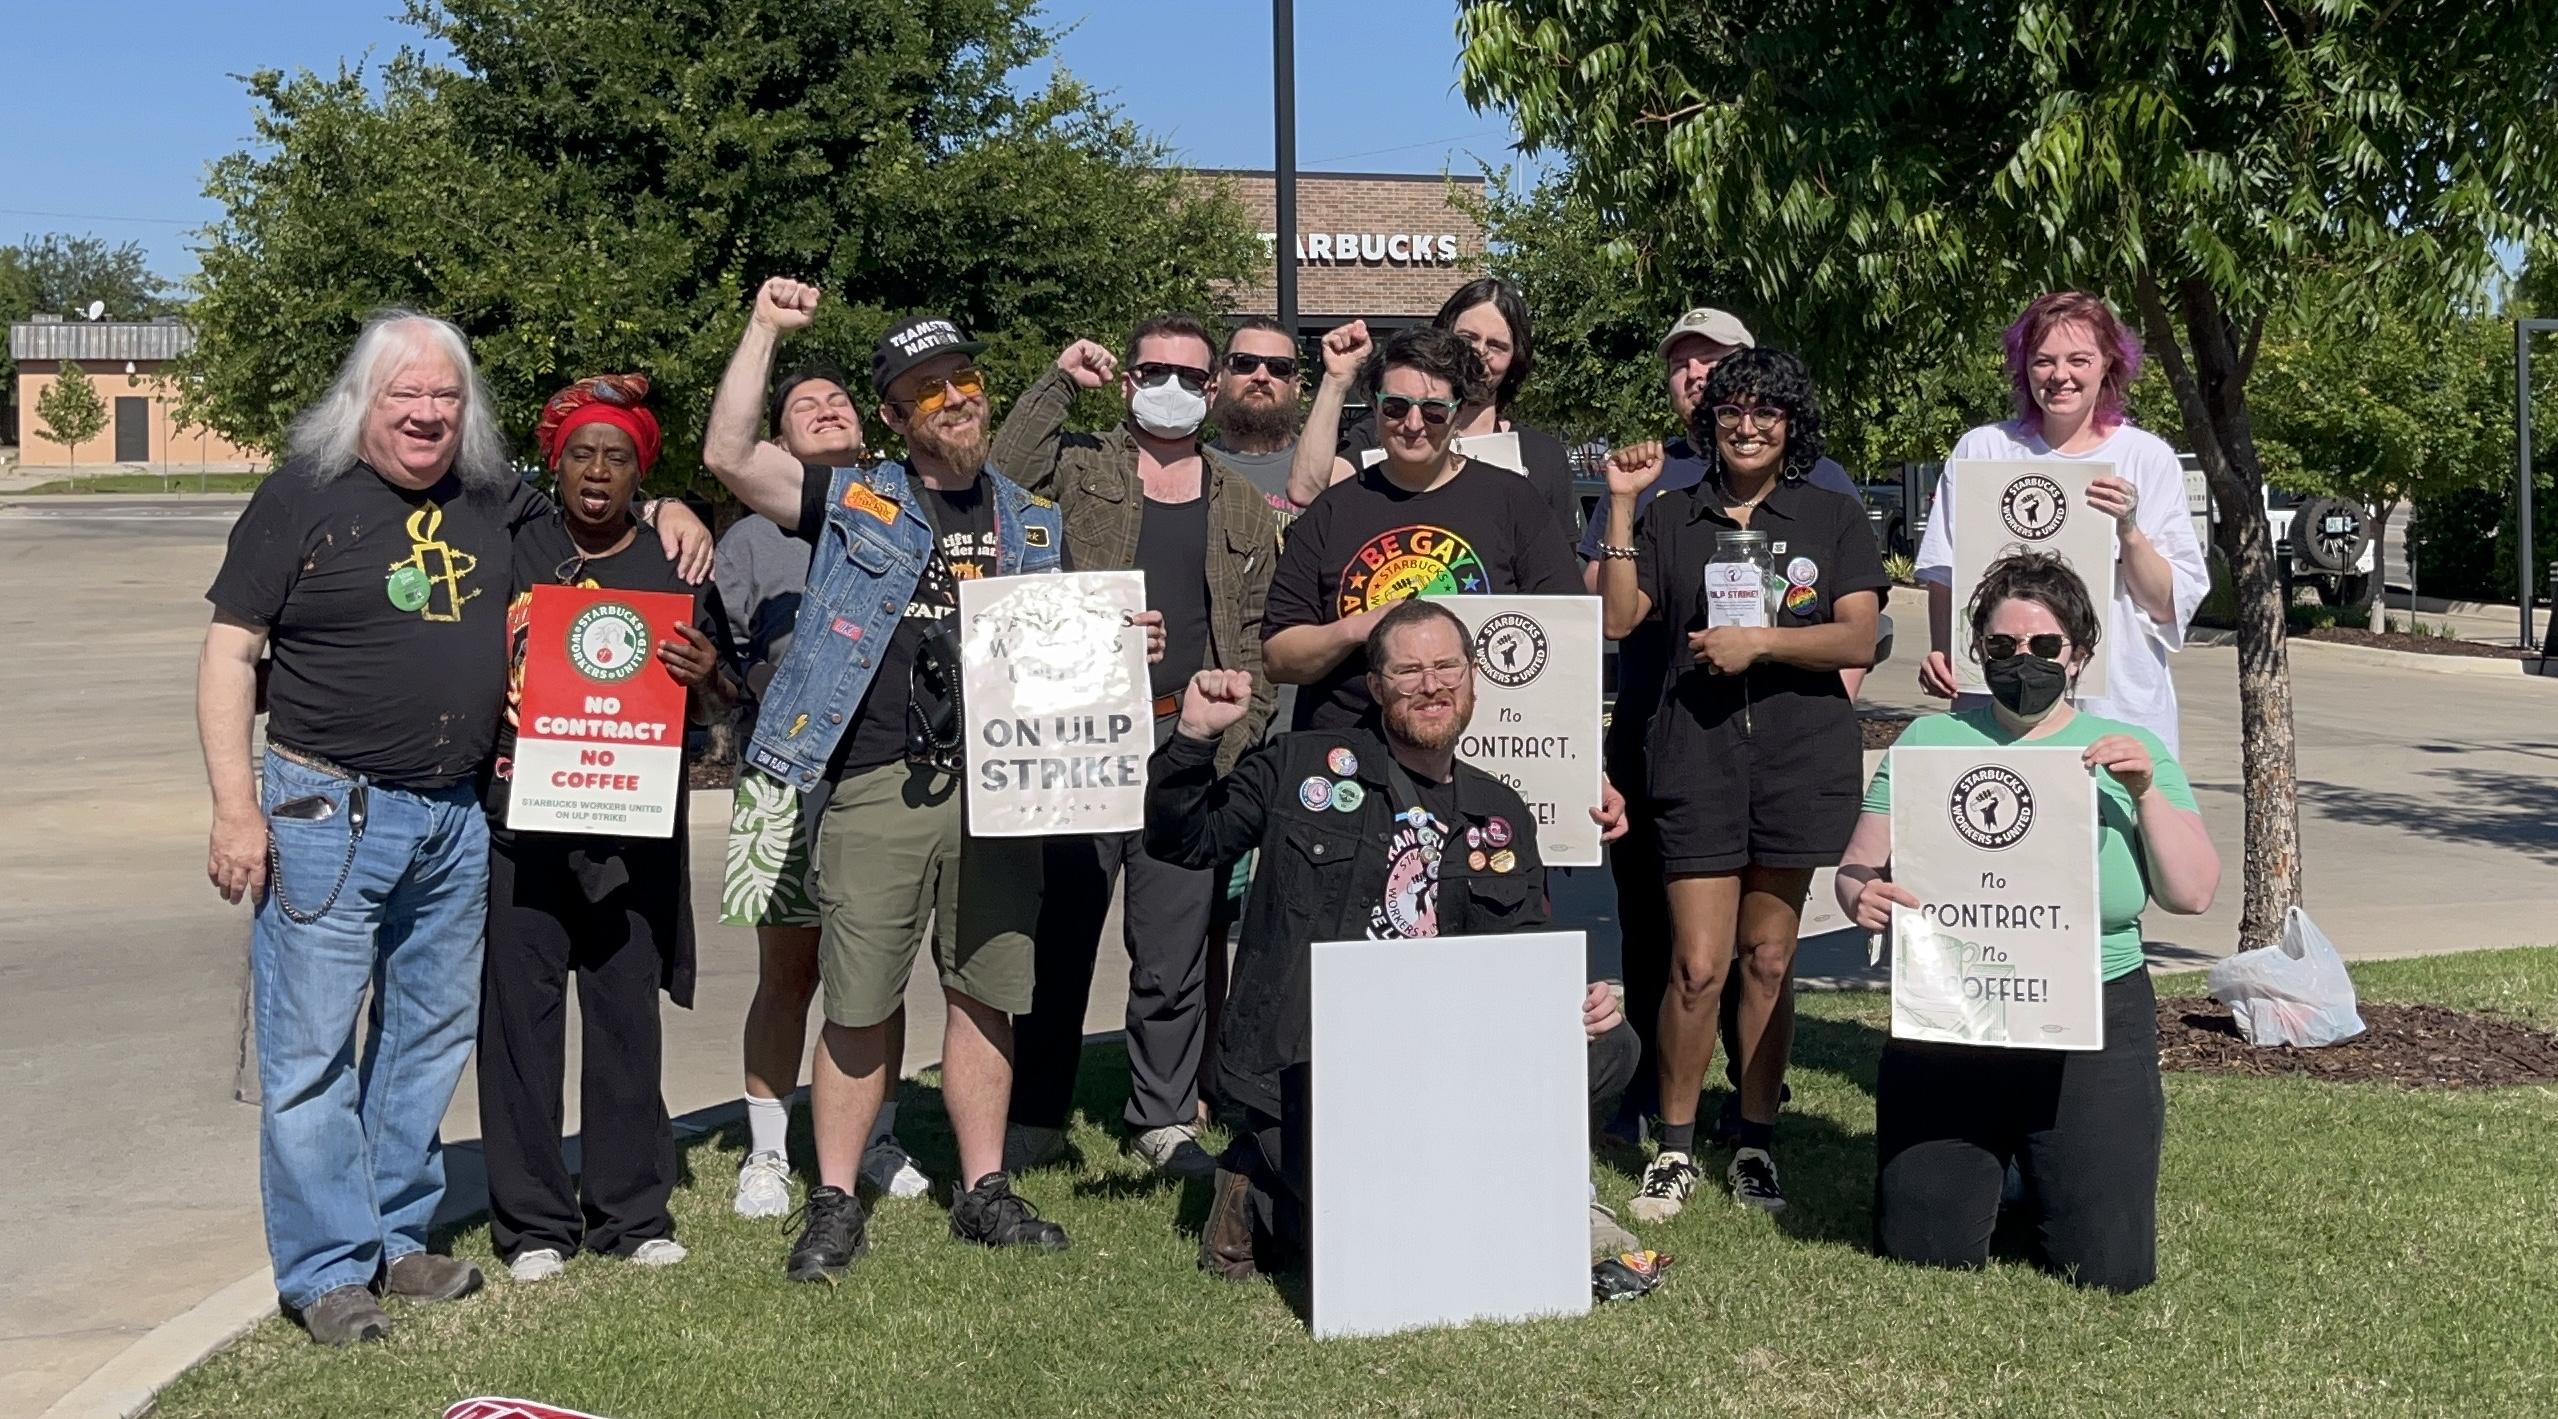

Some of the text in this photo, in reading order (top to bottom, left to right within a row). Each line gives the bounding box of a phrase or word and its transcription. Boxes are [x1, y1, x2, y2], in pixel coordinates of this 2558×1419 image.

[2009, 475, 2061, 498] STARBUCKS
[2002, 504, 2065, 538] WORKERS UNITED
[1360, 531, 1475, 572] BE GAY
[1380, 559, 1449, 583] STARBUCKS
[577, 605, 644, 632] STARBUCKS
[1484, 616, 1541, 640] STARBUCKS
[571, 633, 647, 679] WORKERS UNITED
[1476, 647, 1545, 684] WORKERS UNITED
[584, 695, 621, 715] NO
[534, 716, 667, 741] CONTRACT
[982, 714, 1132, 749] ON ULP
[580, 749, 615, 767] NO
[1456, 736, 1576, 760] ONTRACT,
[551, 770, 640, 792] COFFEE
[981, 754, 1142, 793] STRIKE
[1959, 768, 2025, 796] STARBUCKS
[522, 798, 663, 814] STARBUCKS WORKERS UNITED
[555, 811, 627, 823] ON ULP STRIKE!
[1951, 805, 2031, 846] WORKERS UNITED
[1388, 887, 1419, 938] WORKERS
[1921, 903, 2070, 932] CONTRACT,
[1960, 977, 2048, 1003] OFFEE!
